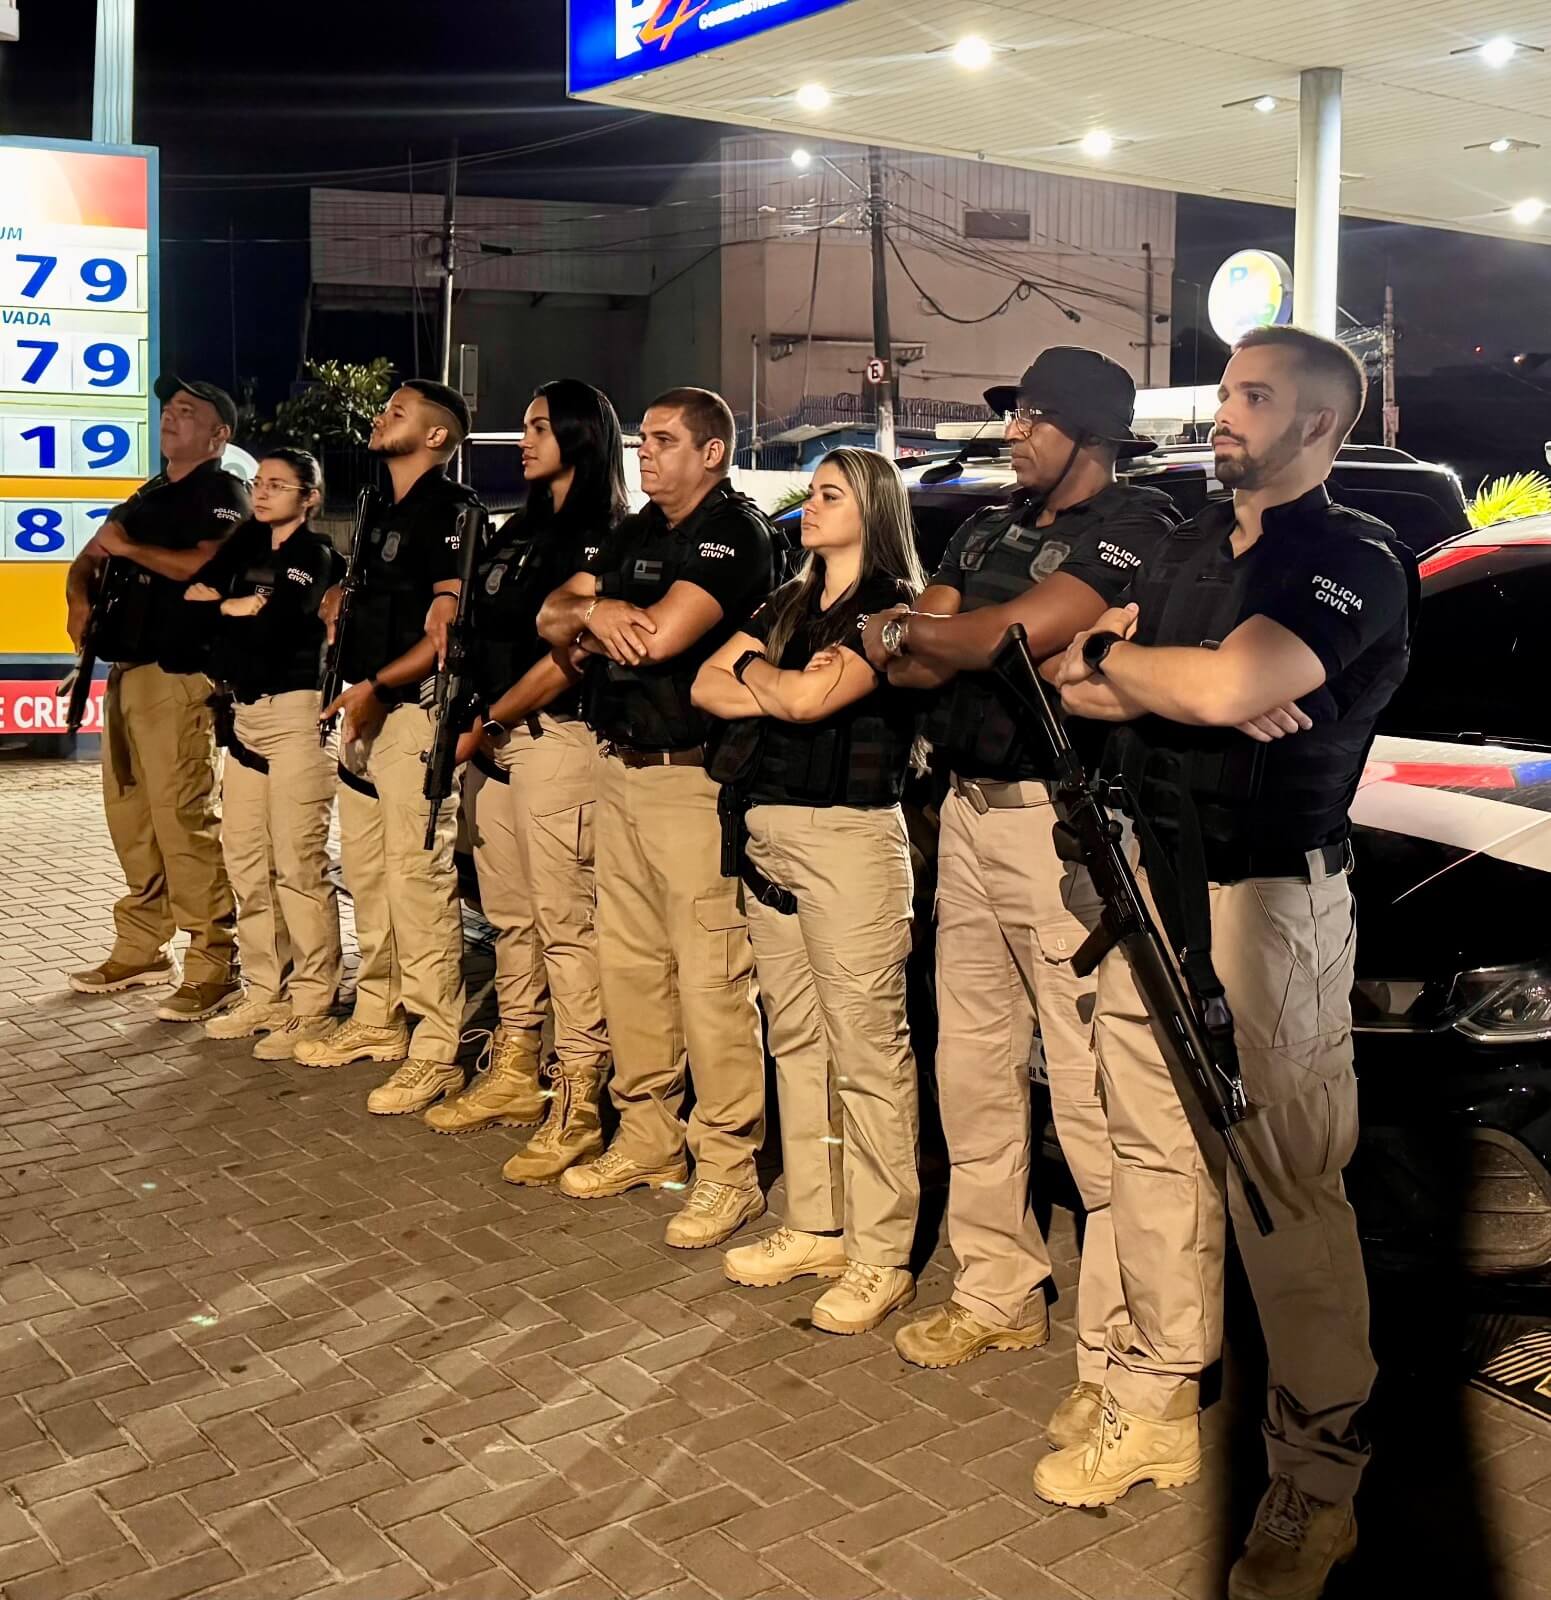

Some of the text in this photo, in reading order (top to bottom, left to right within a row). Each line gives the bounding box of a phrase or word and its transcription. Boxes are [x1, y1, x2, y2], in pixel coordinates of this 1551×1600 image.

[2, 310, 51, 326] VADA
[1314, 590, 1349, 615] CIVIL
[14, 695, 104, 728] CREDI
